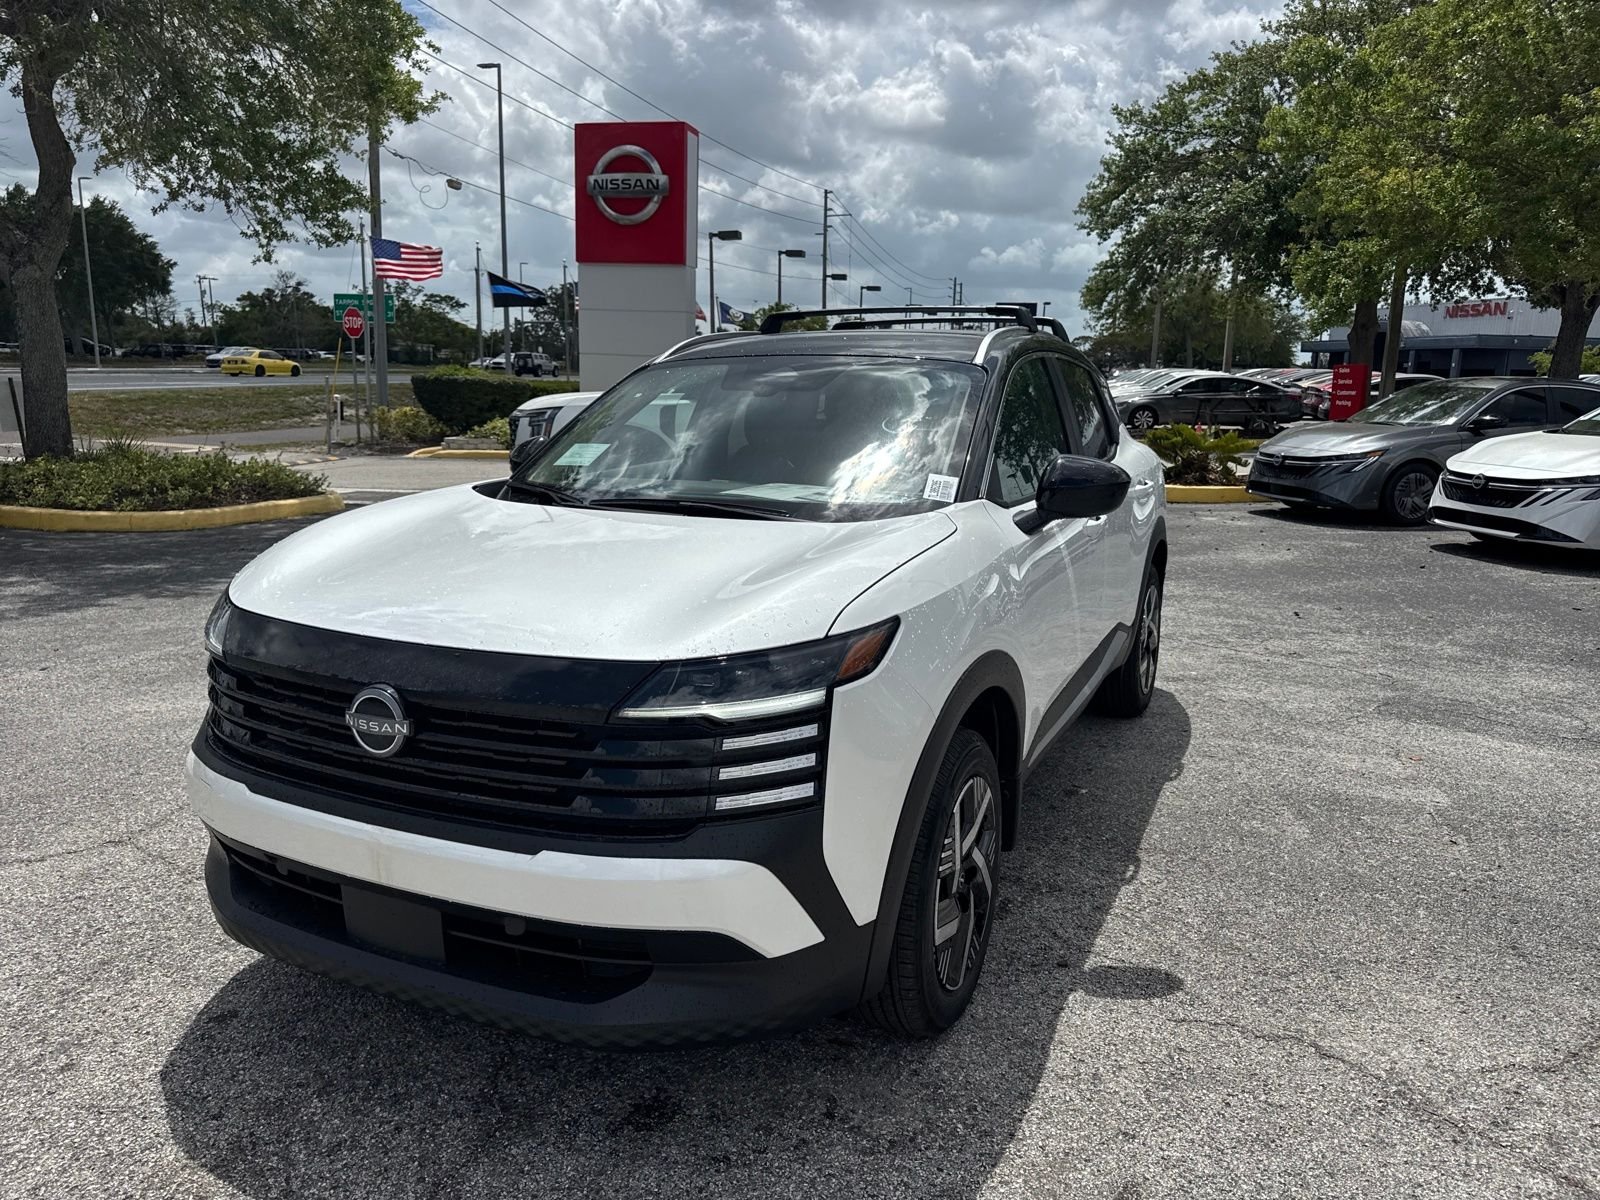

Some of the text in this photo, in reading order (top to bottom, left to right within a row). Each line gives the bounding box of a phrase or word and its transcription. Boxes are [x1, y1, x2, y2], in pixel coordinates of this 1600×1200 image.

[592, 178, 660, 191] NISSAN
[1444, 301, 1509, 319] NISSAN
[344, 317, 363, 329] STOP
[1335, 399, 1352, 407] Parking
[345, 713, 407, 734] NISSAN
